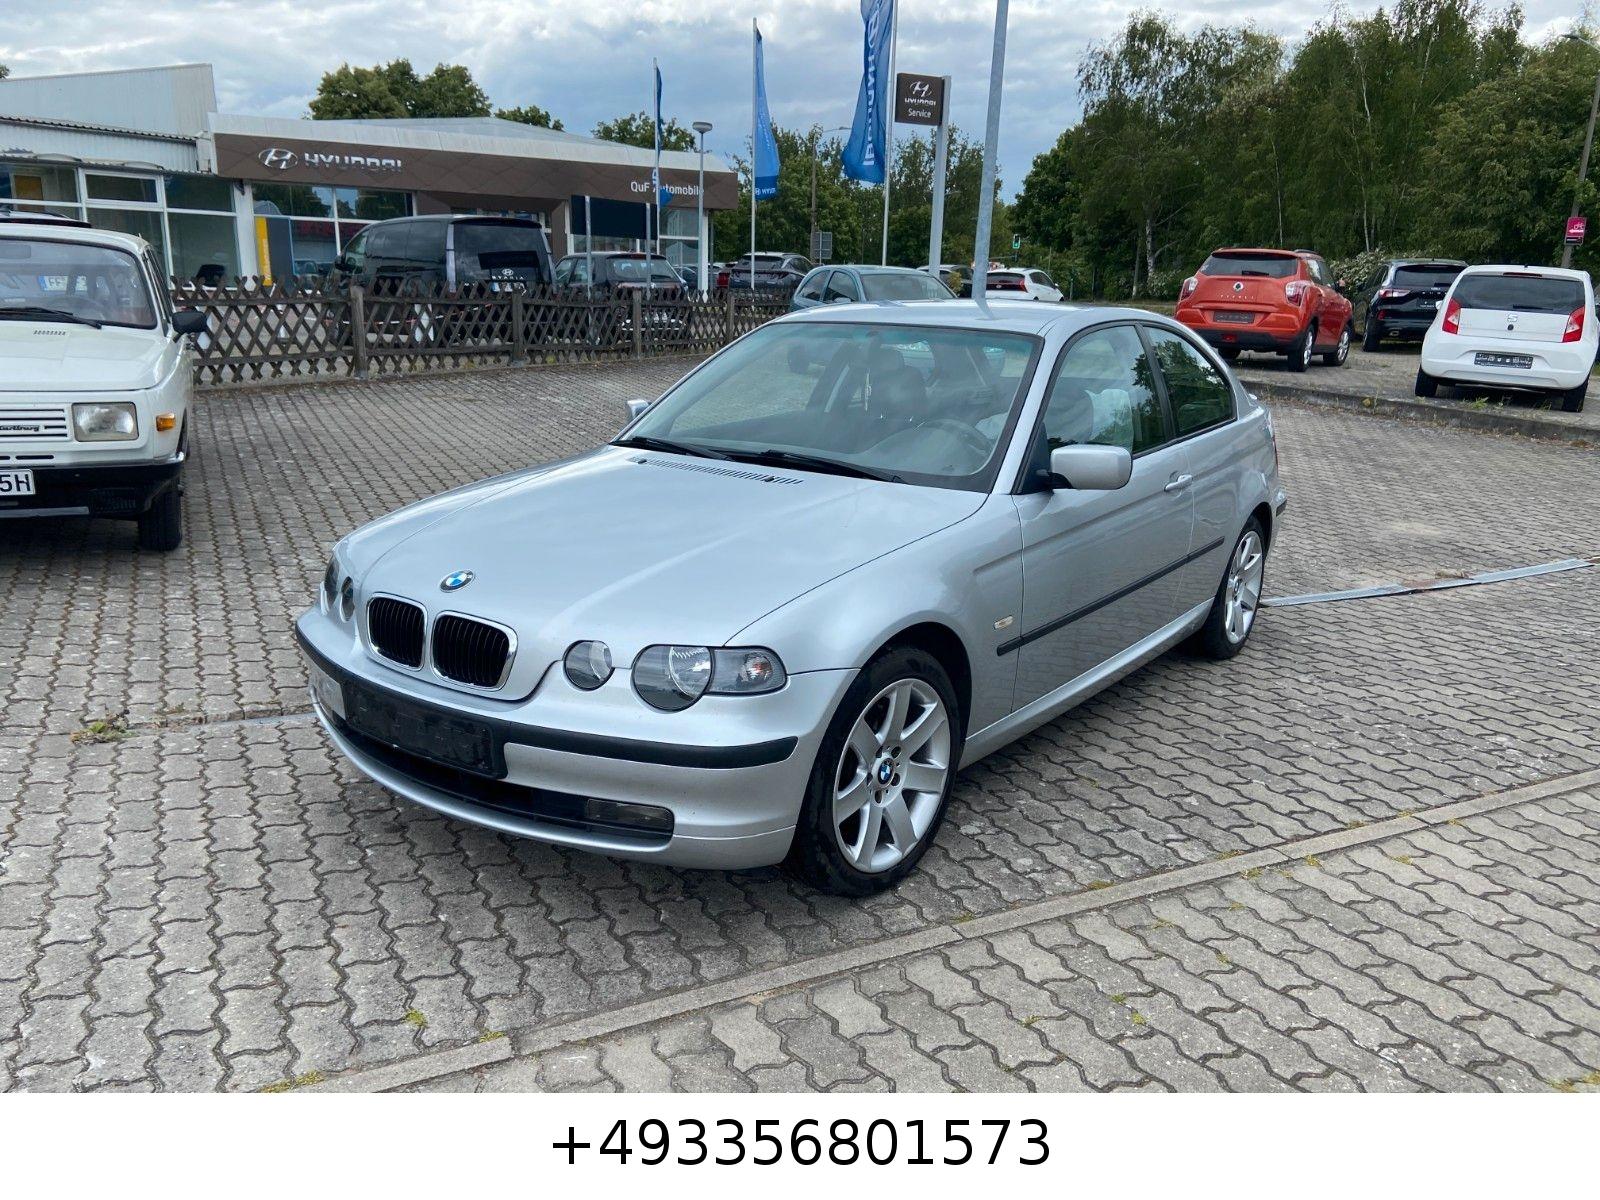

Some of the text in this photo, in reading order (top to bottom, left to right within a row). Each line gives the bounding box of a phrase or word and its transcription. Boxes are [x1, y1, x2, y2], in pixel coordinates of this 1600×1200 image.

[908, 108, 931, 118] Service
[304, 152, 402, 172] HYUNDAI
[630, 181, 650, 193] QuF
[0, 424, 39, 432] artburg
[0, 474, 31, 492] 5H
